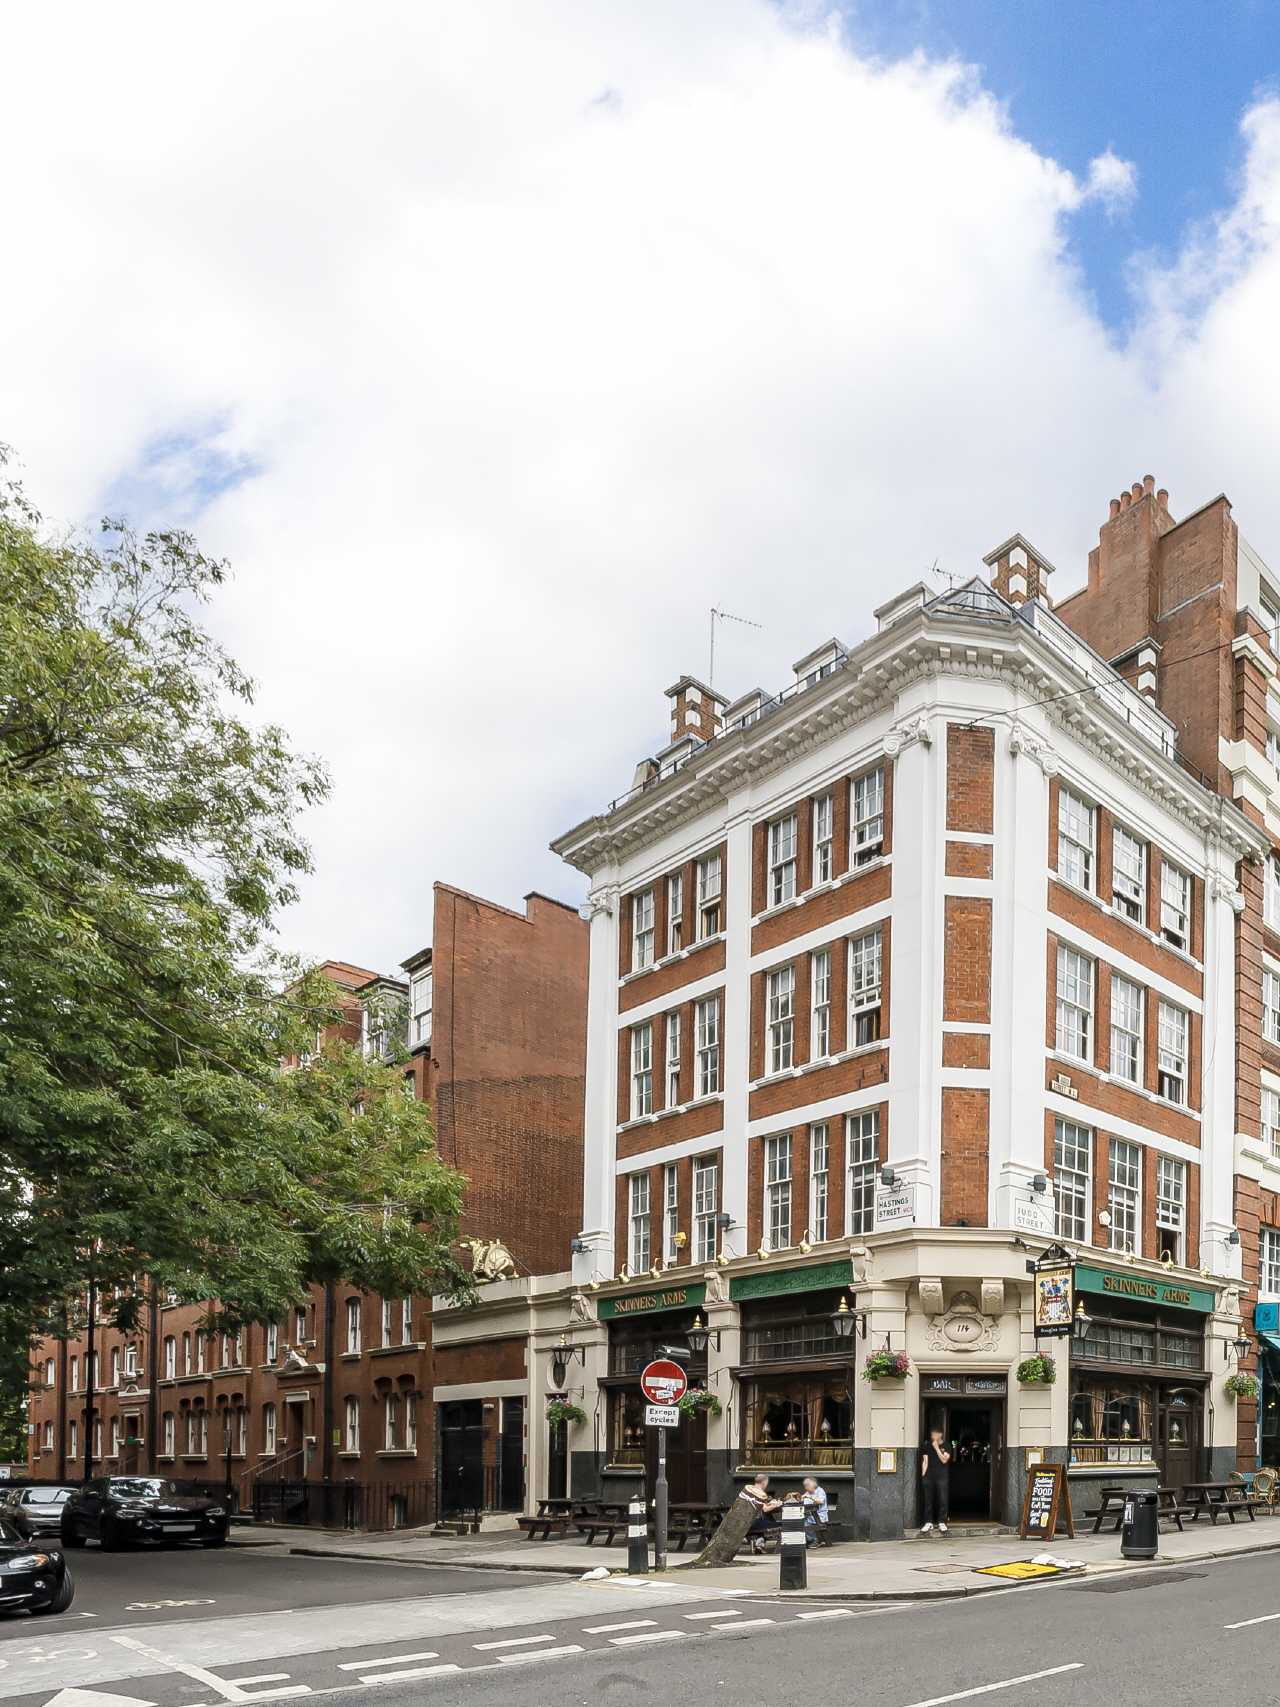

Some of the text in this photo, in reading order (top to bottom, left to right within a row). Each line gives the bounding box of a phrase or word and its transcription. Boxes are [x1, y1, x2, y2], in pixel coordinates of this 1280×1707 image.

[879, 1197, 909, 1208] HASTINGS
[879, 1207, 900, 1217] STREET
[1017, 1208, 1038, 1219] JUDD
[1017, 1216, 1043, 1229] STREET
[1103, 1275, 1191, 1304] SKINNERS ARMS
[614, 1289, 687, 1313] SKINNERS ARMS
[649, 1408, 676, 1416] Except
[1032, 1487, 1053, 1496] FOOD
